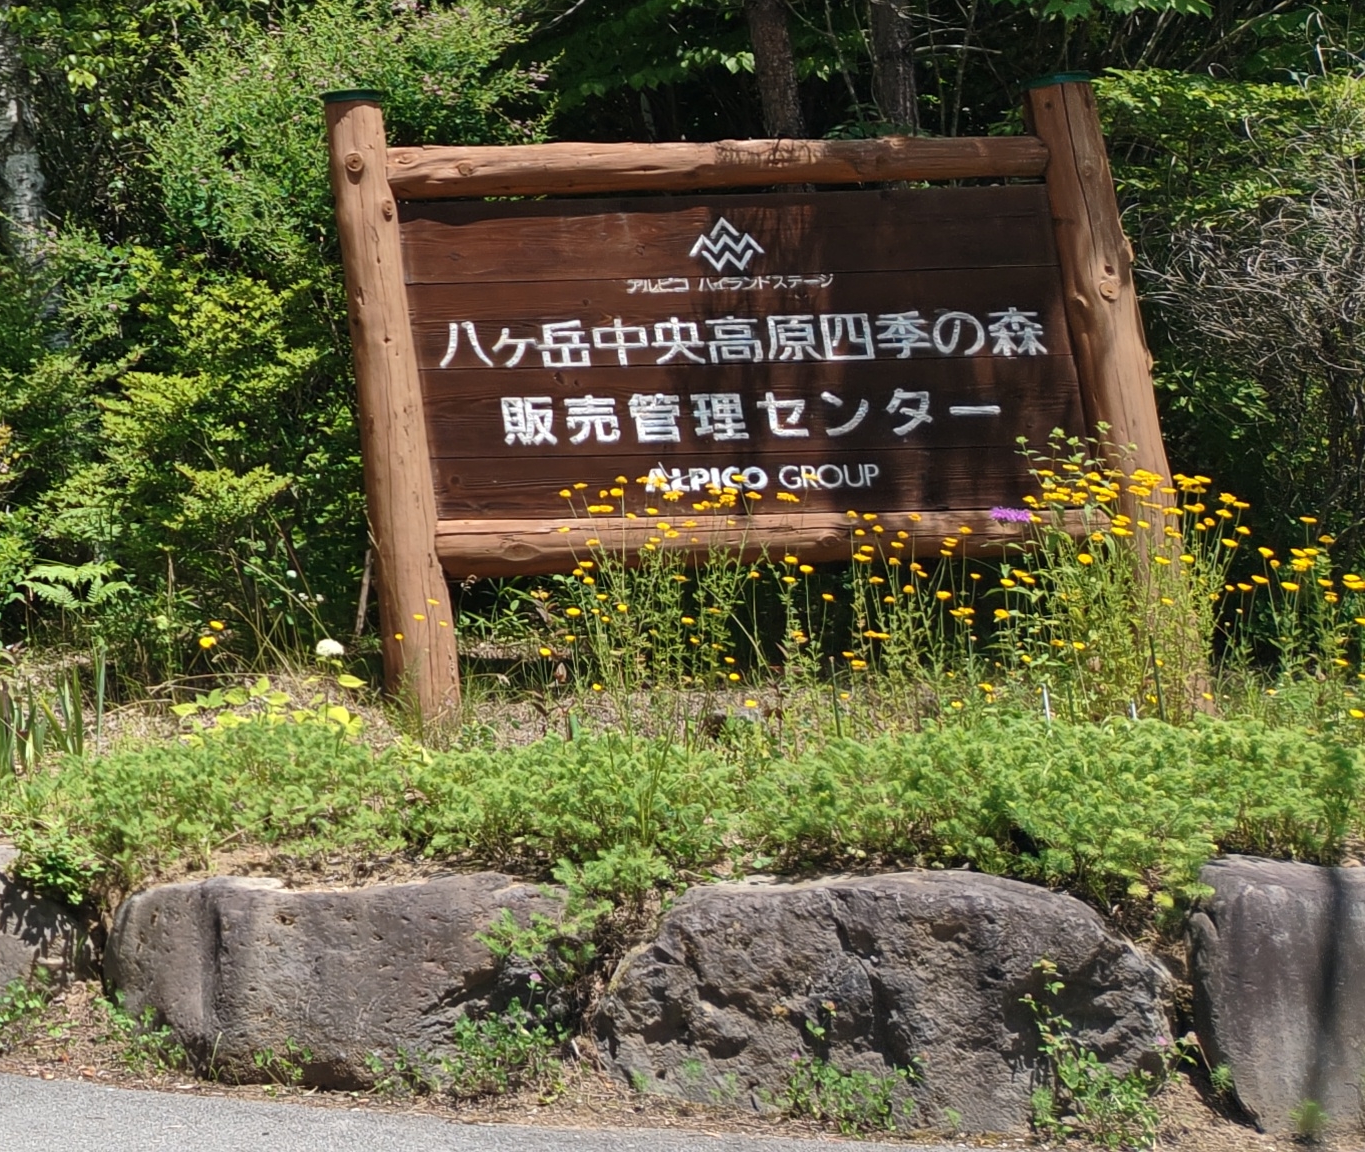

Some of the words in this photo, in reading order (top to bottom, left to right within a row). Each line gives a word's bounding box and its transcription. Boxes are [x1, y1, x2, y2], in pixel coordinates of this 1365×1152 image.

[626, 277, 690, 294] アルピコ
[698, 273, 834, 292] ハイランドステージ
[500, 387, 1001, 447] 販売管理センター
[645, 465, 769, 493] ALPICO
[778, 463, 879, 491] GROUP
